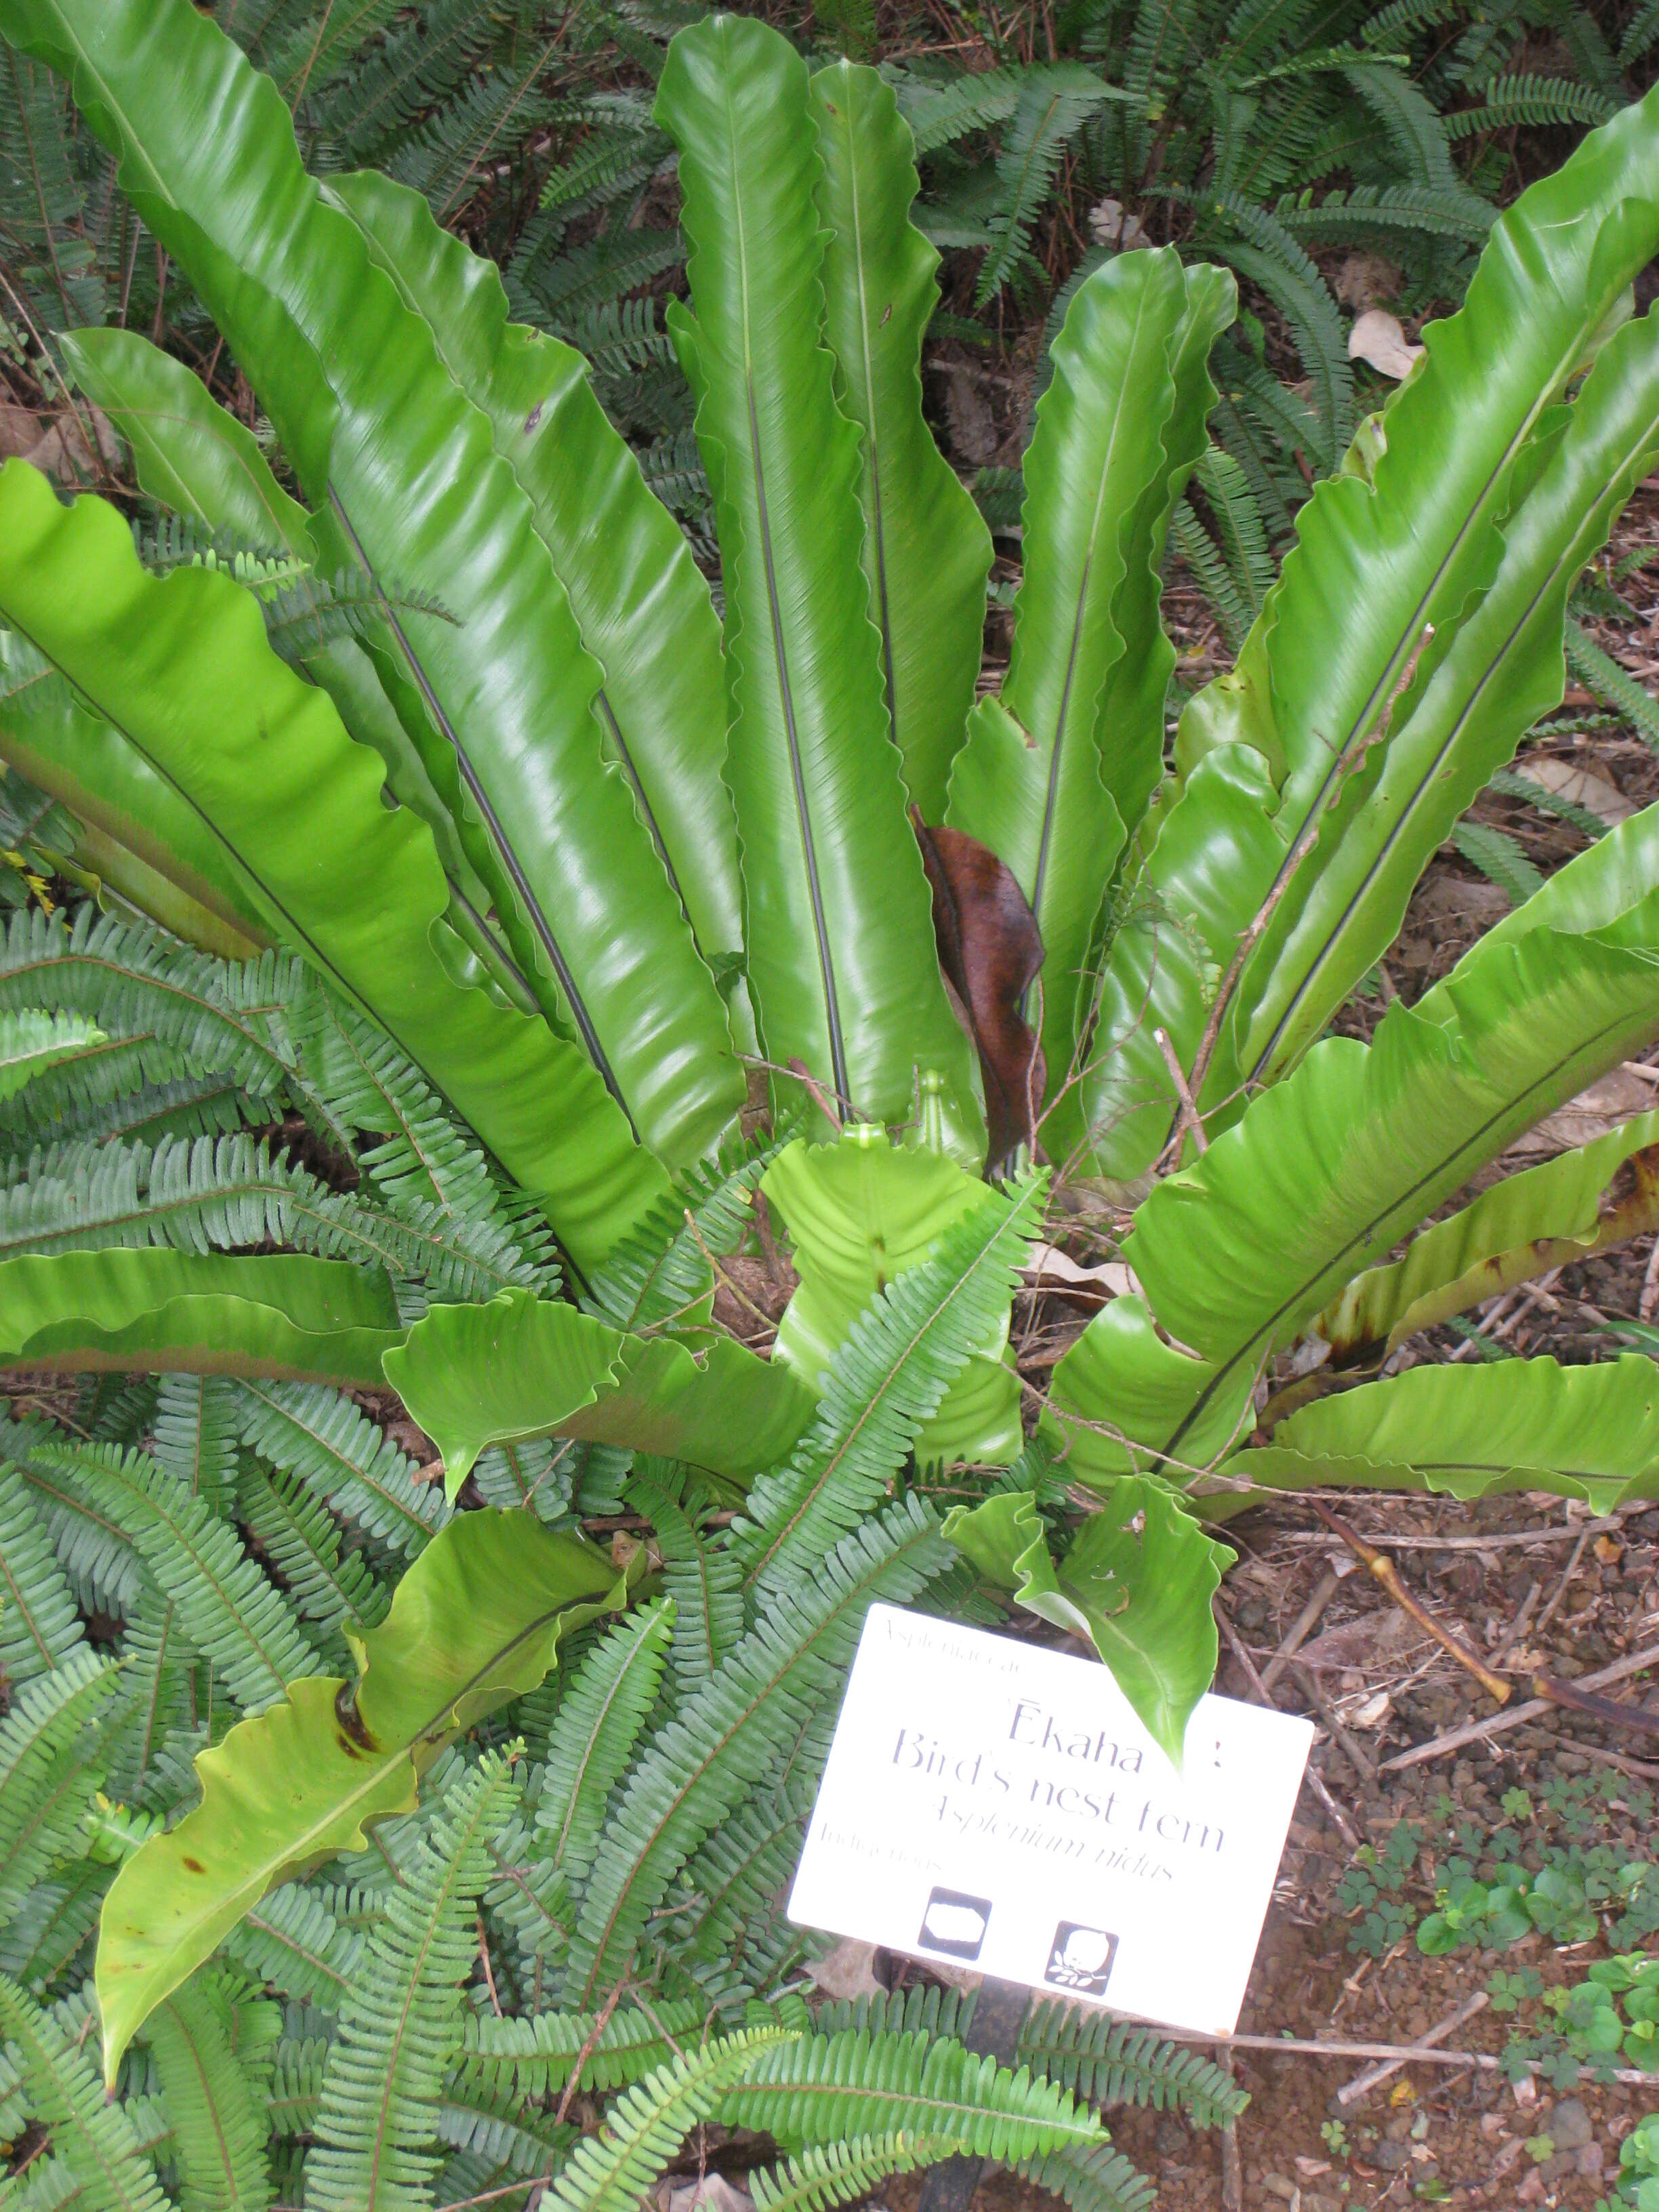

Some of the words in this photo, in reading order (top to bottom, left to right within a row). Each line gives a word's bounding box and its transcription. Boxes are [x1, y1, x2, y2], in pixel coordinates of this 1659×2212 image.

[893, 1729, 1010, 1793] Bird's
[1029, 1778, 1122, 1825] nest
[1138, 1800, 1225, 1853] fern
[933, 1795, 1086, 1858] Asplenium
[1094, 1847, 1173, 1881] nidus
